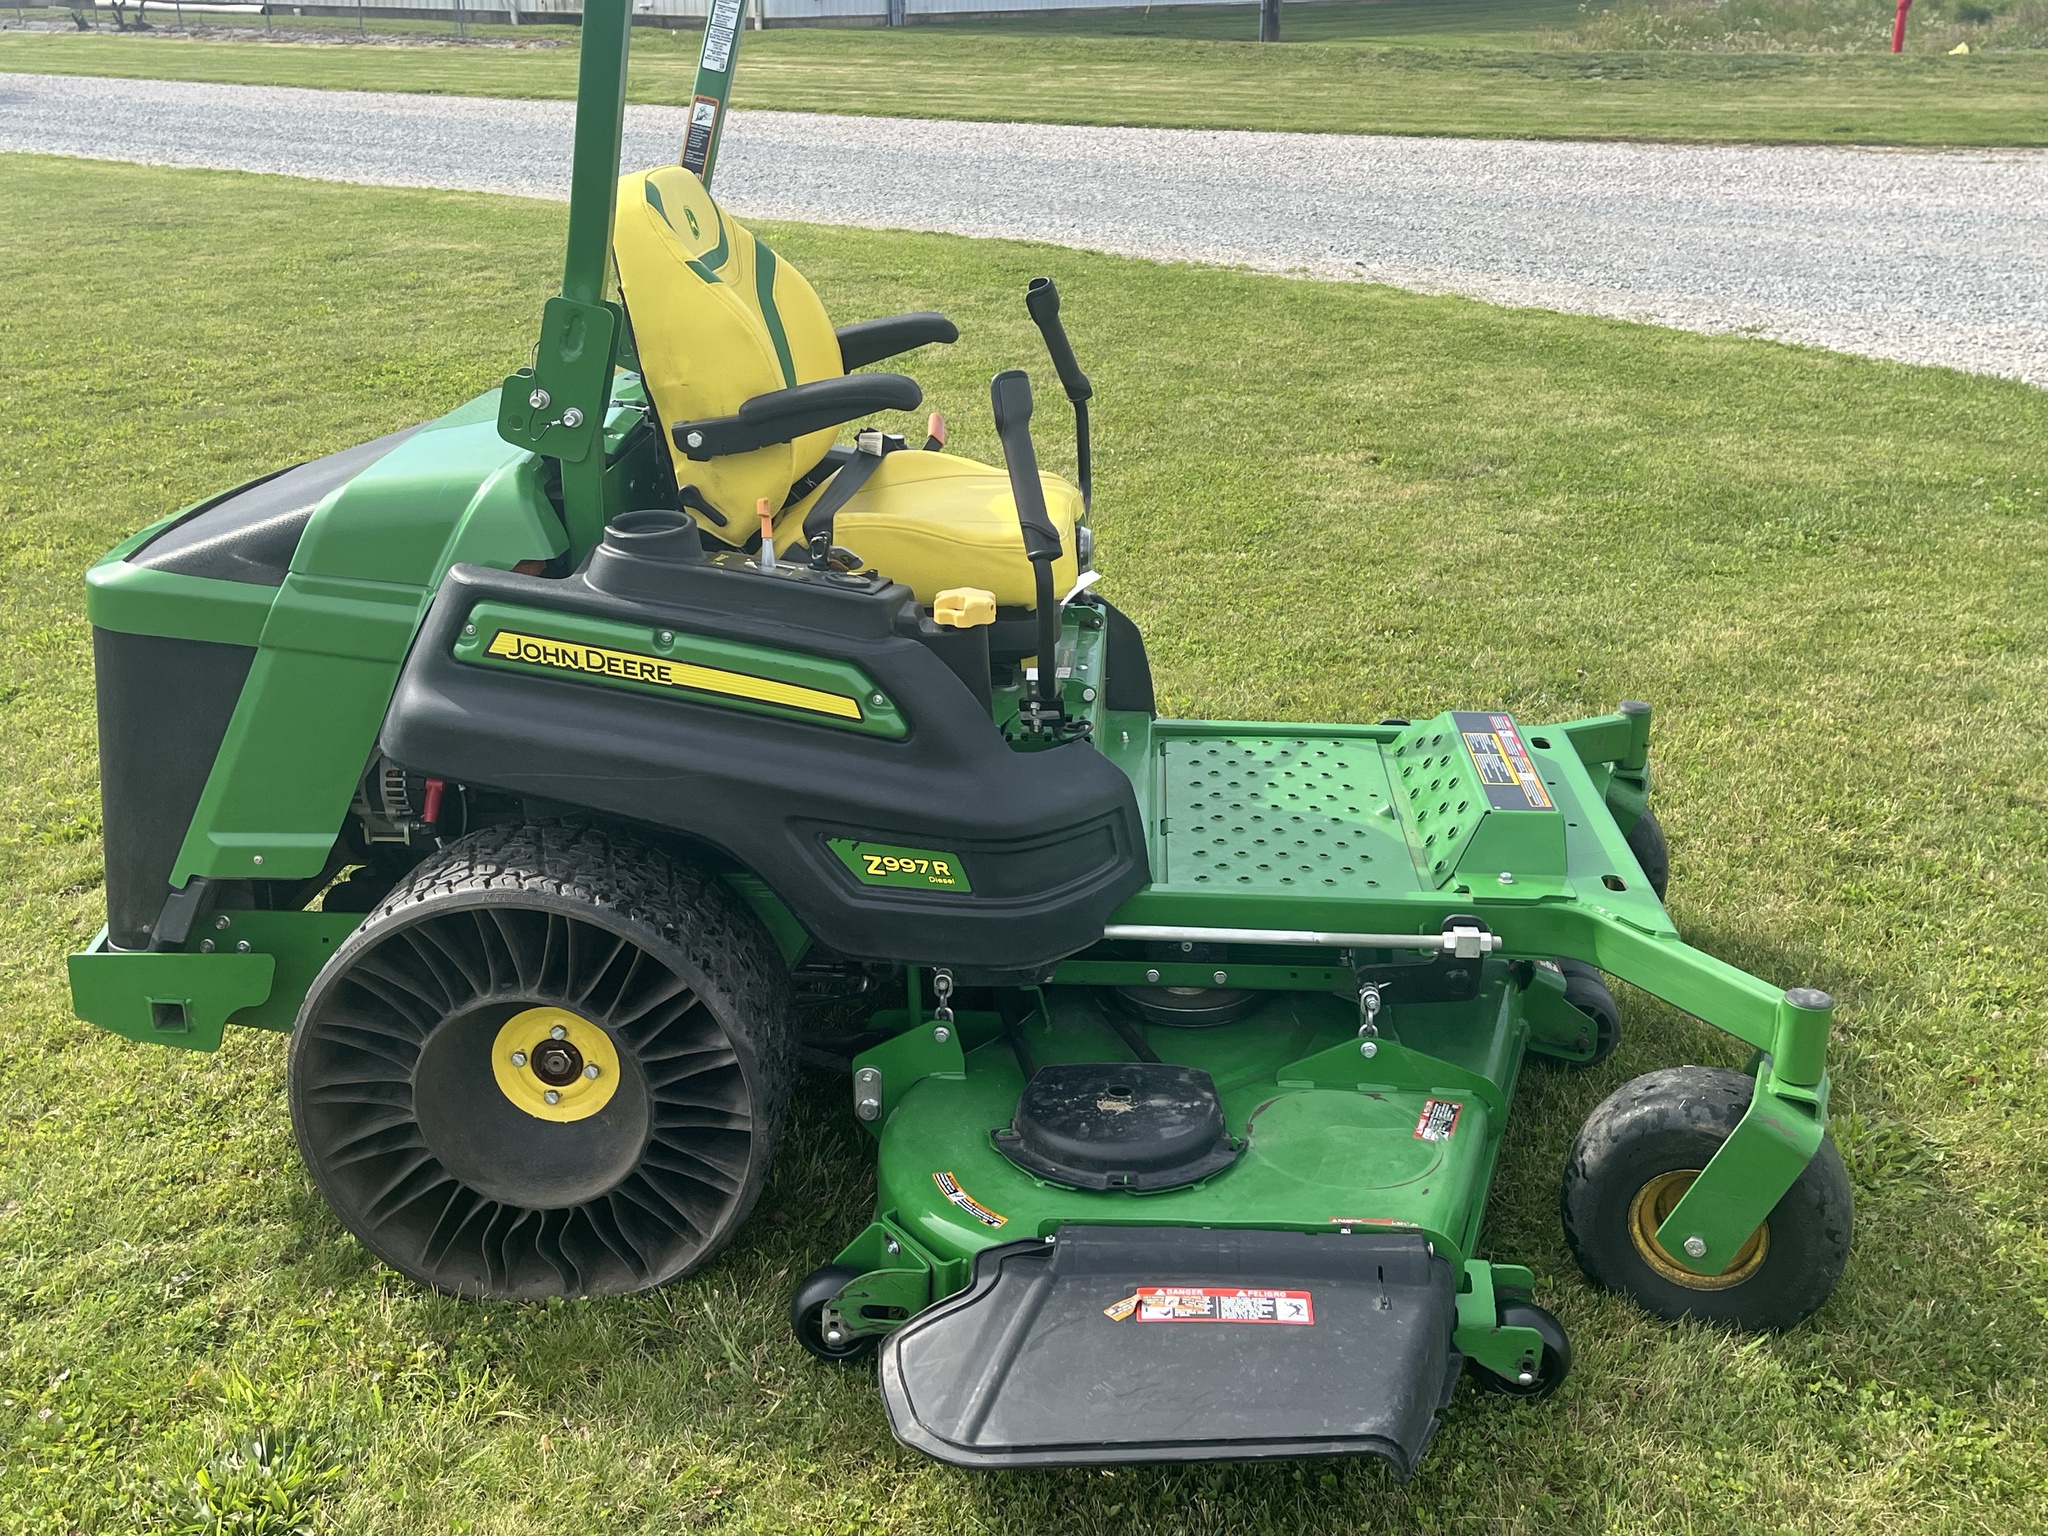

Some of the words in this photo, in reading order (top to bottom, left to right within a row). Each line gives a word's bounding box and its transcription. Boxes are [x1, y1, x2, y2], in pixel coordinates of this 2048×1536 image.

[508, 638, 579, 667] JOHN
[585, 649, 672, 683] DEERE
[928, 876, 955, 885] Diesel
[1166, 1288, 1203, 1296] DANGER
[1247, 1289, 1287, 1298] PELIGRO
